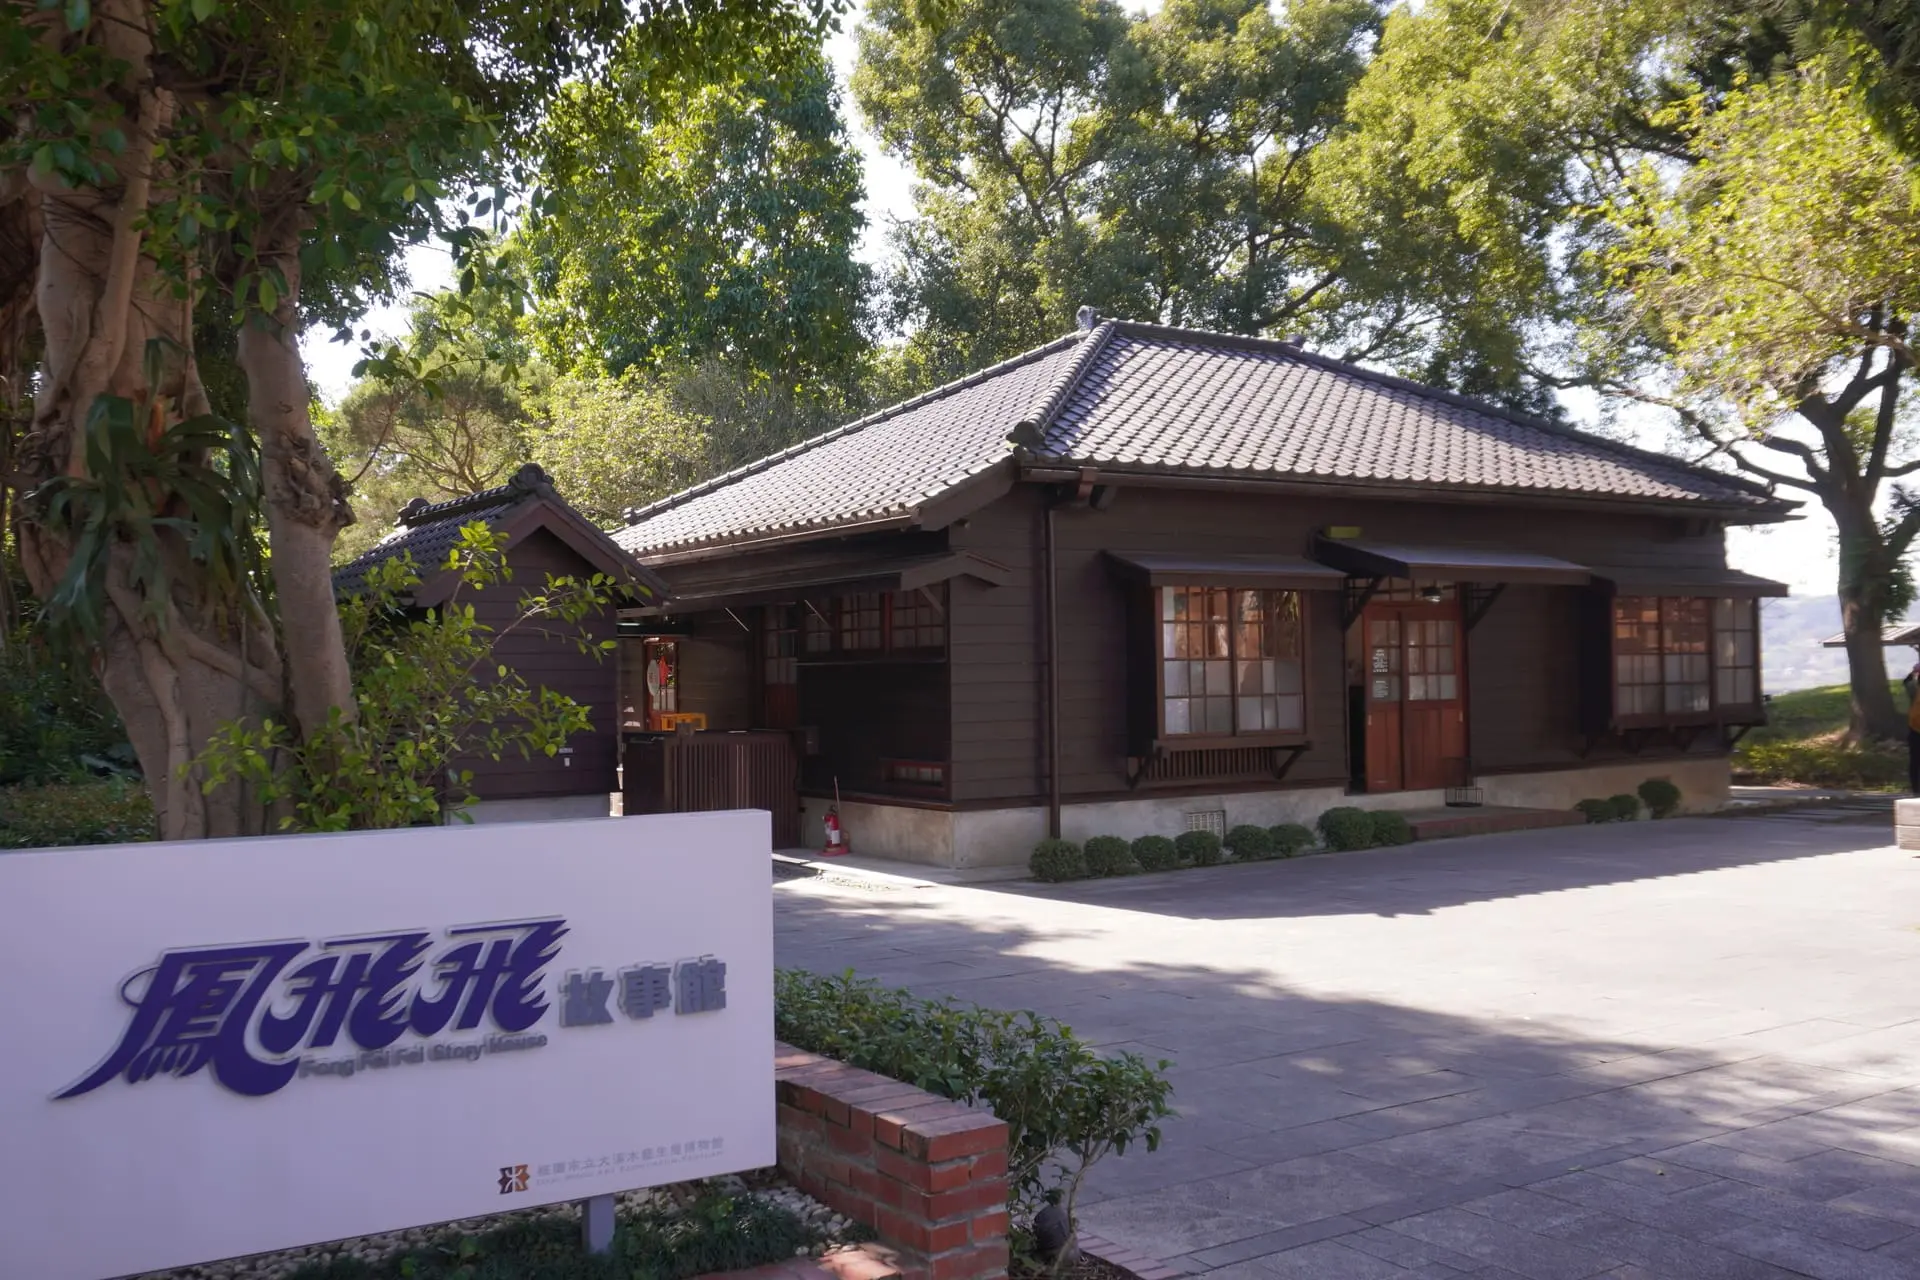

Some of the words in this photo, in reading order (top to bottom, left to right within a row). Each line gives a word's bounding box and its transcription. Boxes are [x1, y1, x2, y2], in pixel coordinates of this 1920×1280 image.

[559, 954, 727, 1029] 故事館
[356, 1049, 390, 1071] Fei
[391, 1045, 425, 1067] Fei
[428, 1043, 485, 1062] Story
[488, 1033, 549, 1055] House
